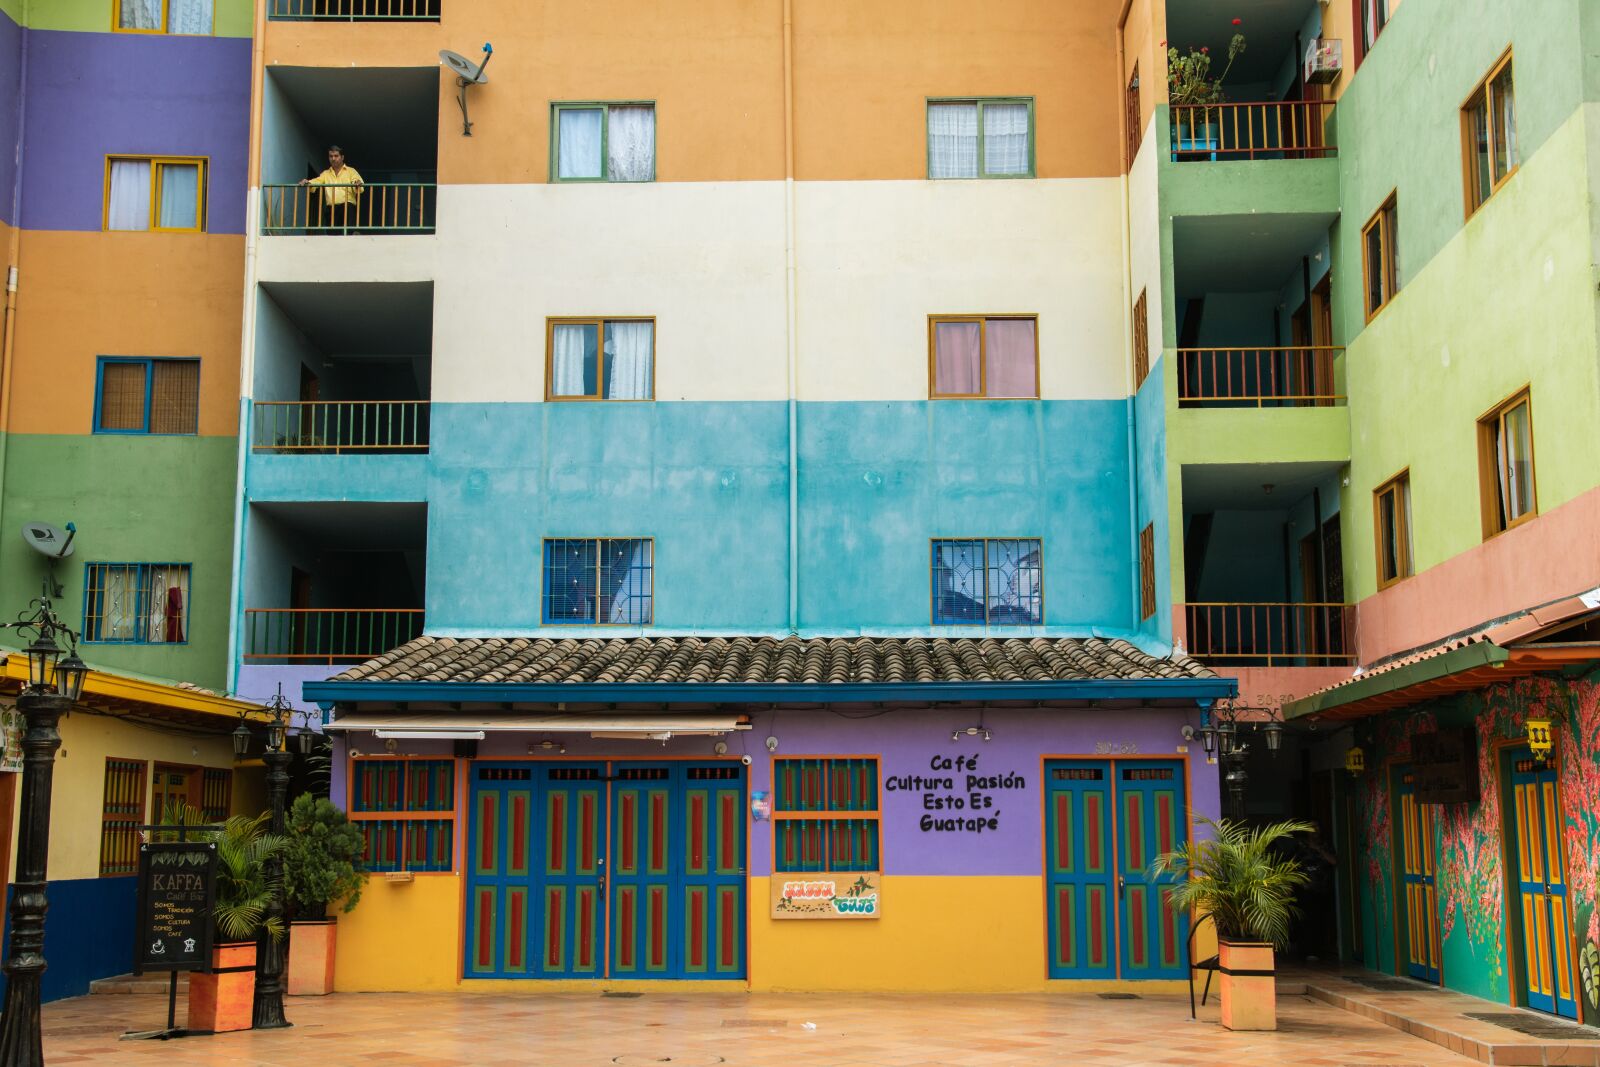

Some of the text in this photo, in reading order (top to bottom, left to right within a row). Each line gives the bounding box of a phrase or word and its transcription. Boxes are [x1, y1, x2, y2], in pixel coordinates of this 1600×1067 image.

[930, 753, 979, 773] Café
[885, 774, 953, 791] Cultura
[923, 793, 992, 810] Esto Es
[920, 810, 1000, 834] Guatapé
[152, 874, 204, 890] KAFFA
